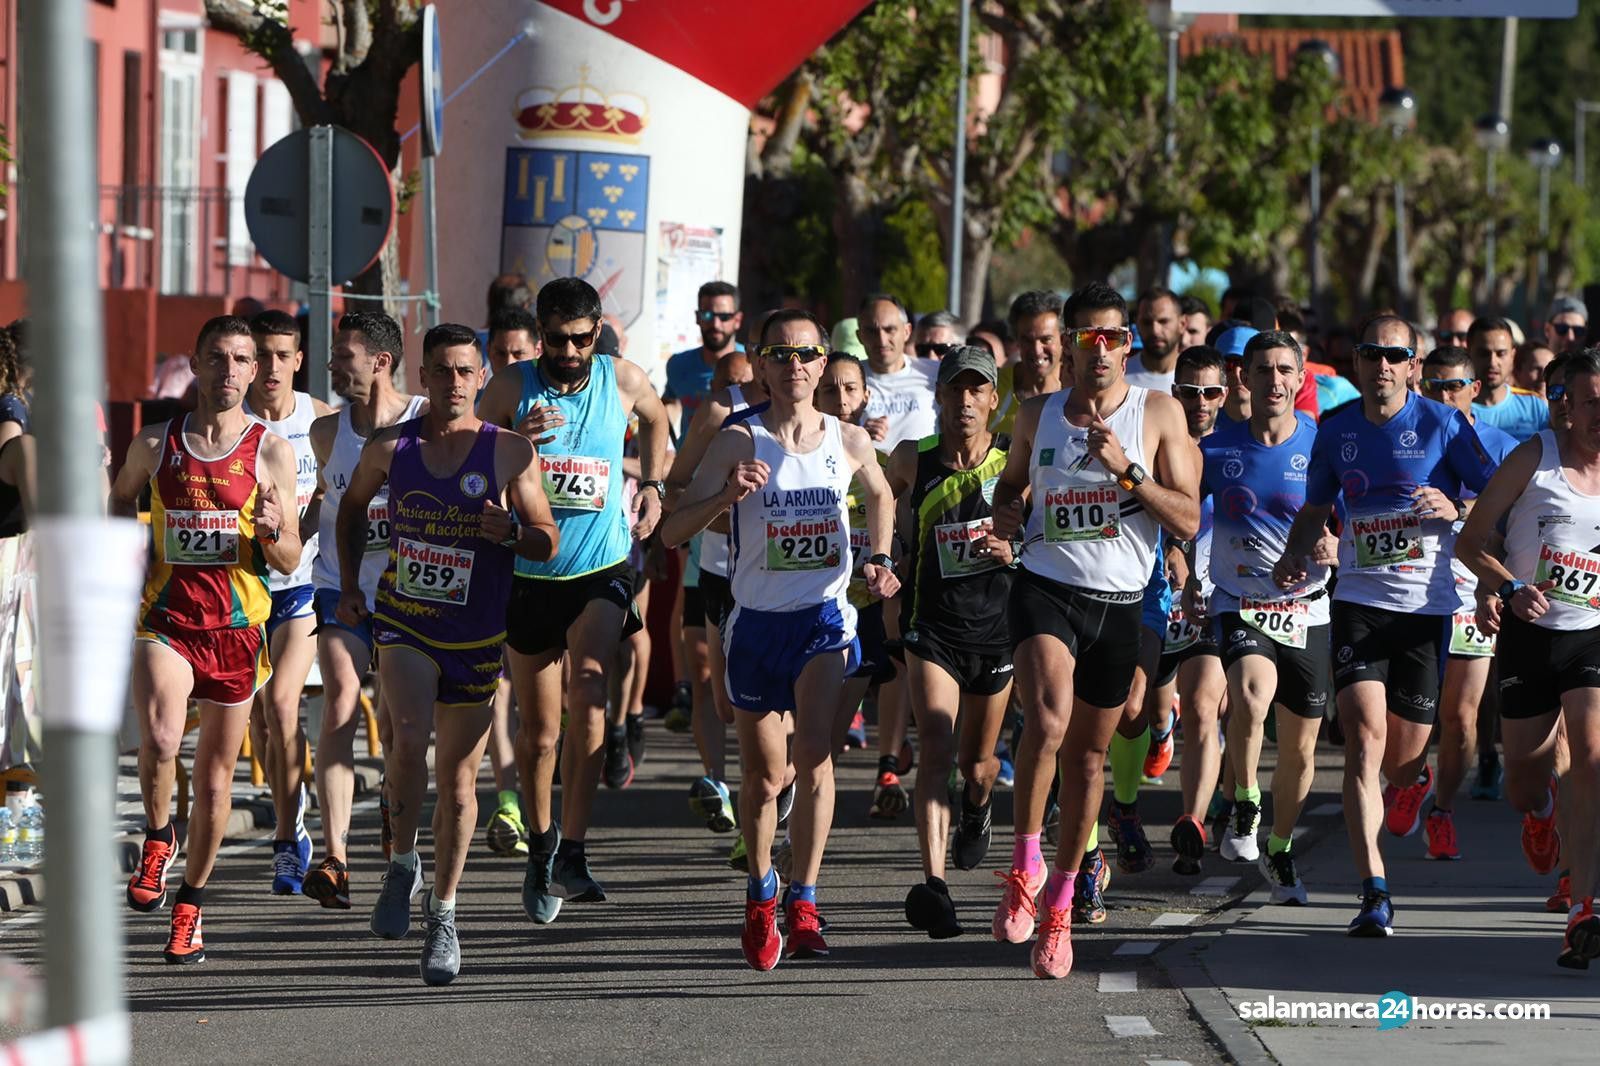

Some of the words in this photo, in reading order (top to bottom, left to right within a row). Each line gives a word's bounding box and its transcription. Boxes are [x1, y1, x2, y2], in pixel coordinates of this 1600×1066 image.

[540, 457, 609, 477] bedunia
[186, 487, 216, 499] VINO
[551, 473, 596, 497] 743
[176, 498, 190, 507] DE
[193, 498, 226, 510] TORO
[762, 491, 780, 508] LA
[1045, 487, 1118, 507] bedunia
[166, 514, 238, 529] bedunia
[770, 509, 787, 517] CLUB
[1055, 504, 1104, 530] 810
[766, 518, 840, 540] bedunia
[178, 530, 221, 551] 921
[781, 536, 829, 560] 920
[1366, 530, 1409, 556] 936
[399, 541, 472, 570] bedunia
[407, 561, 456, 588] 959
[1550, 565, 1598, 595] 867
[1254, 612, 1294, 634] 906
